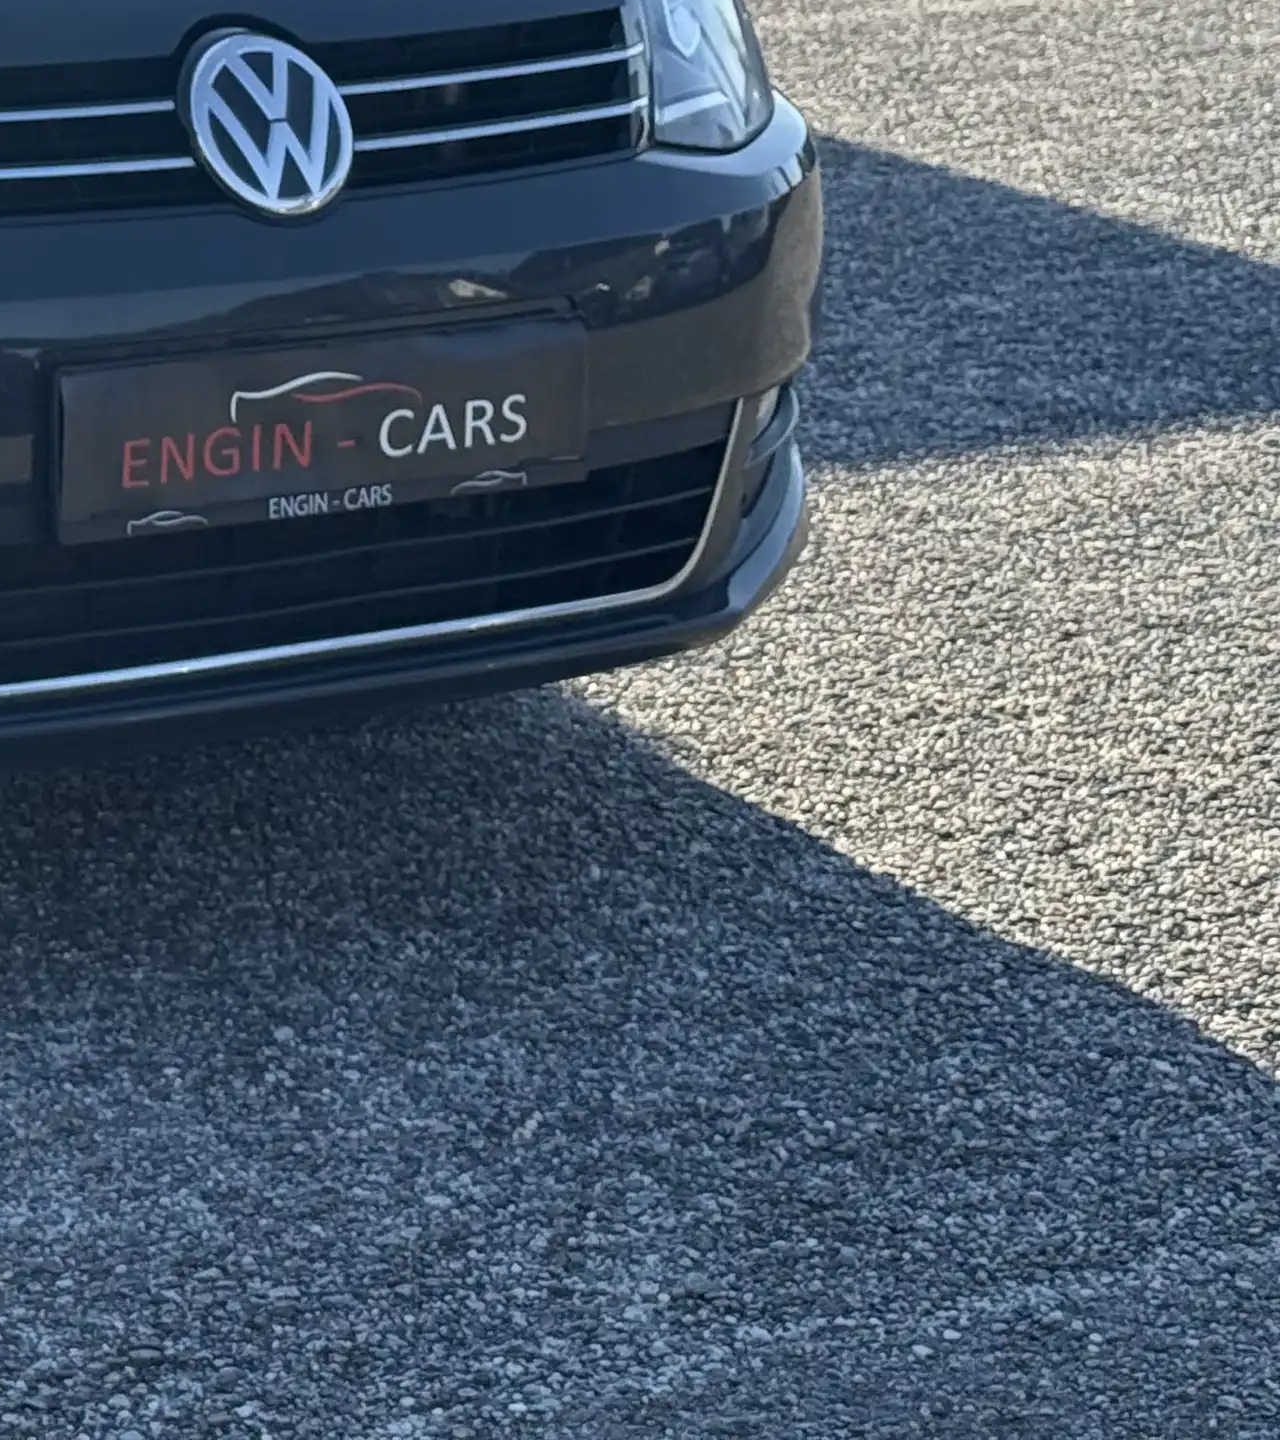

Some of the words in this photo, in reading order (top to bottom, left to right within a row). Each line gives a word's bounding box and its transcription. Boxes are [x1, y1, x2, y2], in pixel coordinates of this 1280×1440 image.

[122, 420, 313, 489] ENGIN
[379, 394, 528, 457] CARS
[268, 493, 329, 520] ENGIN
[344, 485, 393, 510] CARS
